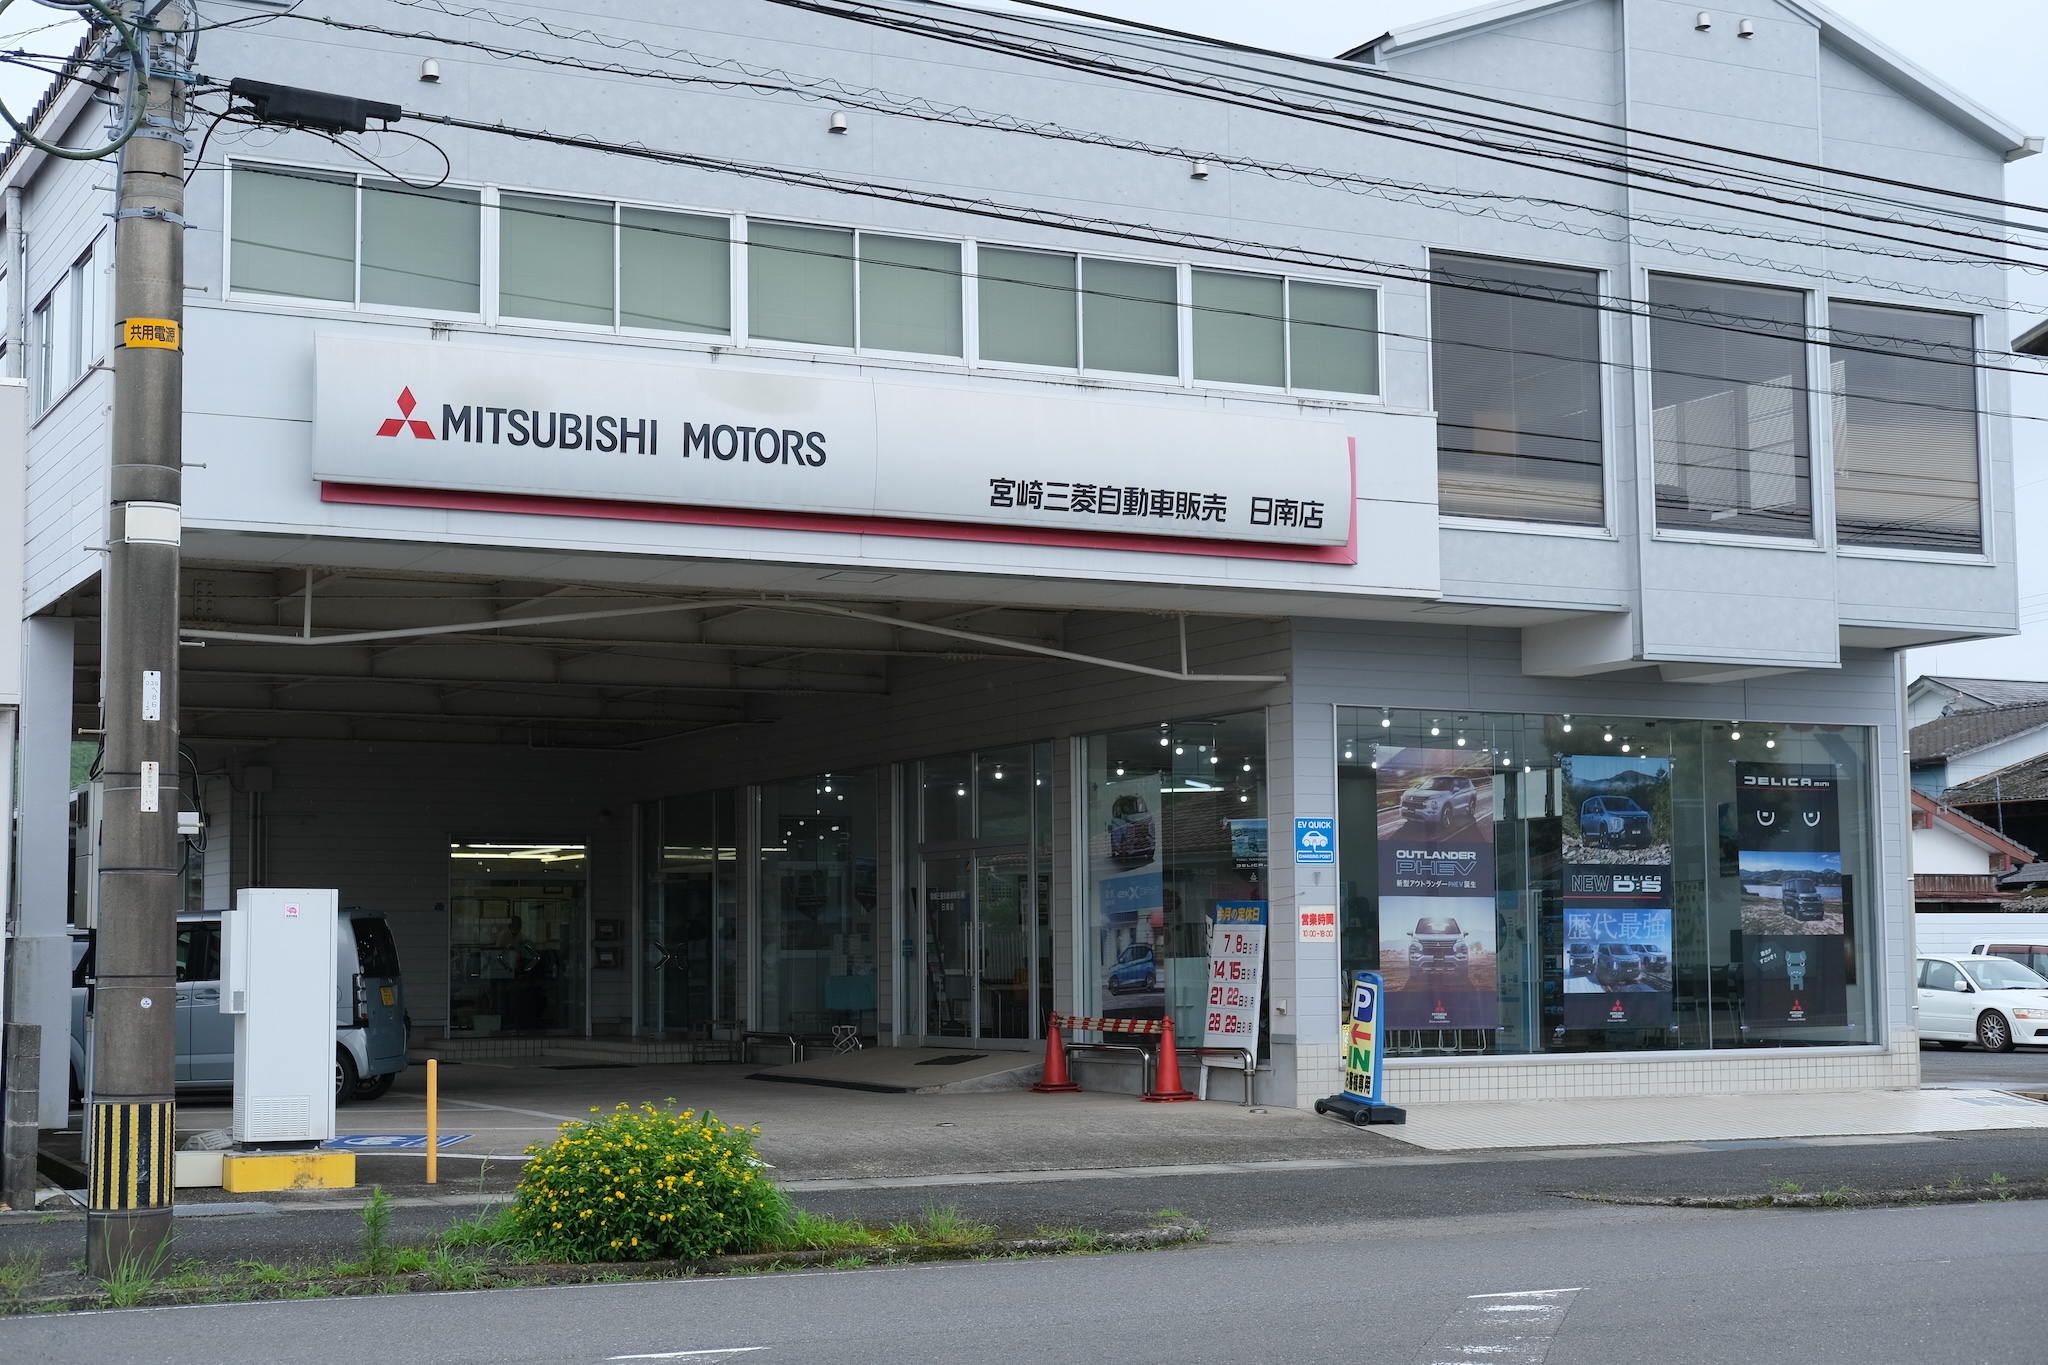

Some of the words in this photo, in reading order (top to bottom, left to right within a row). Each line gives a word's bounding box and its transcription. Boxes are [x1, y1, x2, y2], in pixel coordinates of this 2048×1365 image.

[130, 324, 175, 343] 共用電源
[442, 403, 658, 455] MITSUBISHI
[683, 422, 827, 467] MOTORS
[989, 477, 1227, 522] 宮崎三菱自動車販売
[1250, 496, 1324, 529] 日南店
[1743, 775, 1812, 787] DELICA
[1297, 821, 1307, 829] EV
[1308, 821, 1331, 829] QUICK
[1396, 849, 1476, 860] OUTLANDER
[1395, 859, 1477, 876] PHEV
[1571, 874, 1610, 892] NEW
[1217, 906, 1261, 922] 今月の定休日
[1301, 913, 1334, 926] 営業時間
[1567, 911, 1667, 941] 歴代最強
[1354, 989, 1372, 1018] P
[1348, 1046, 1371, 1073] IN
